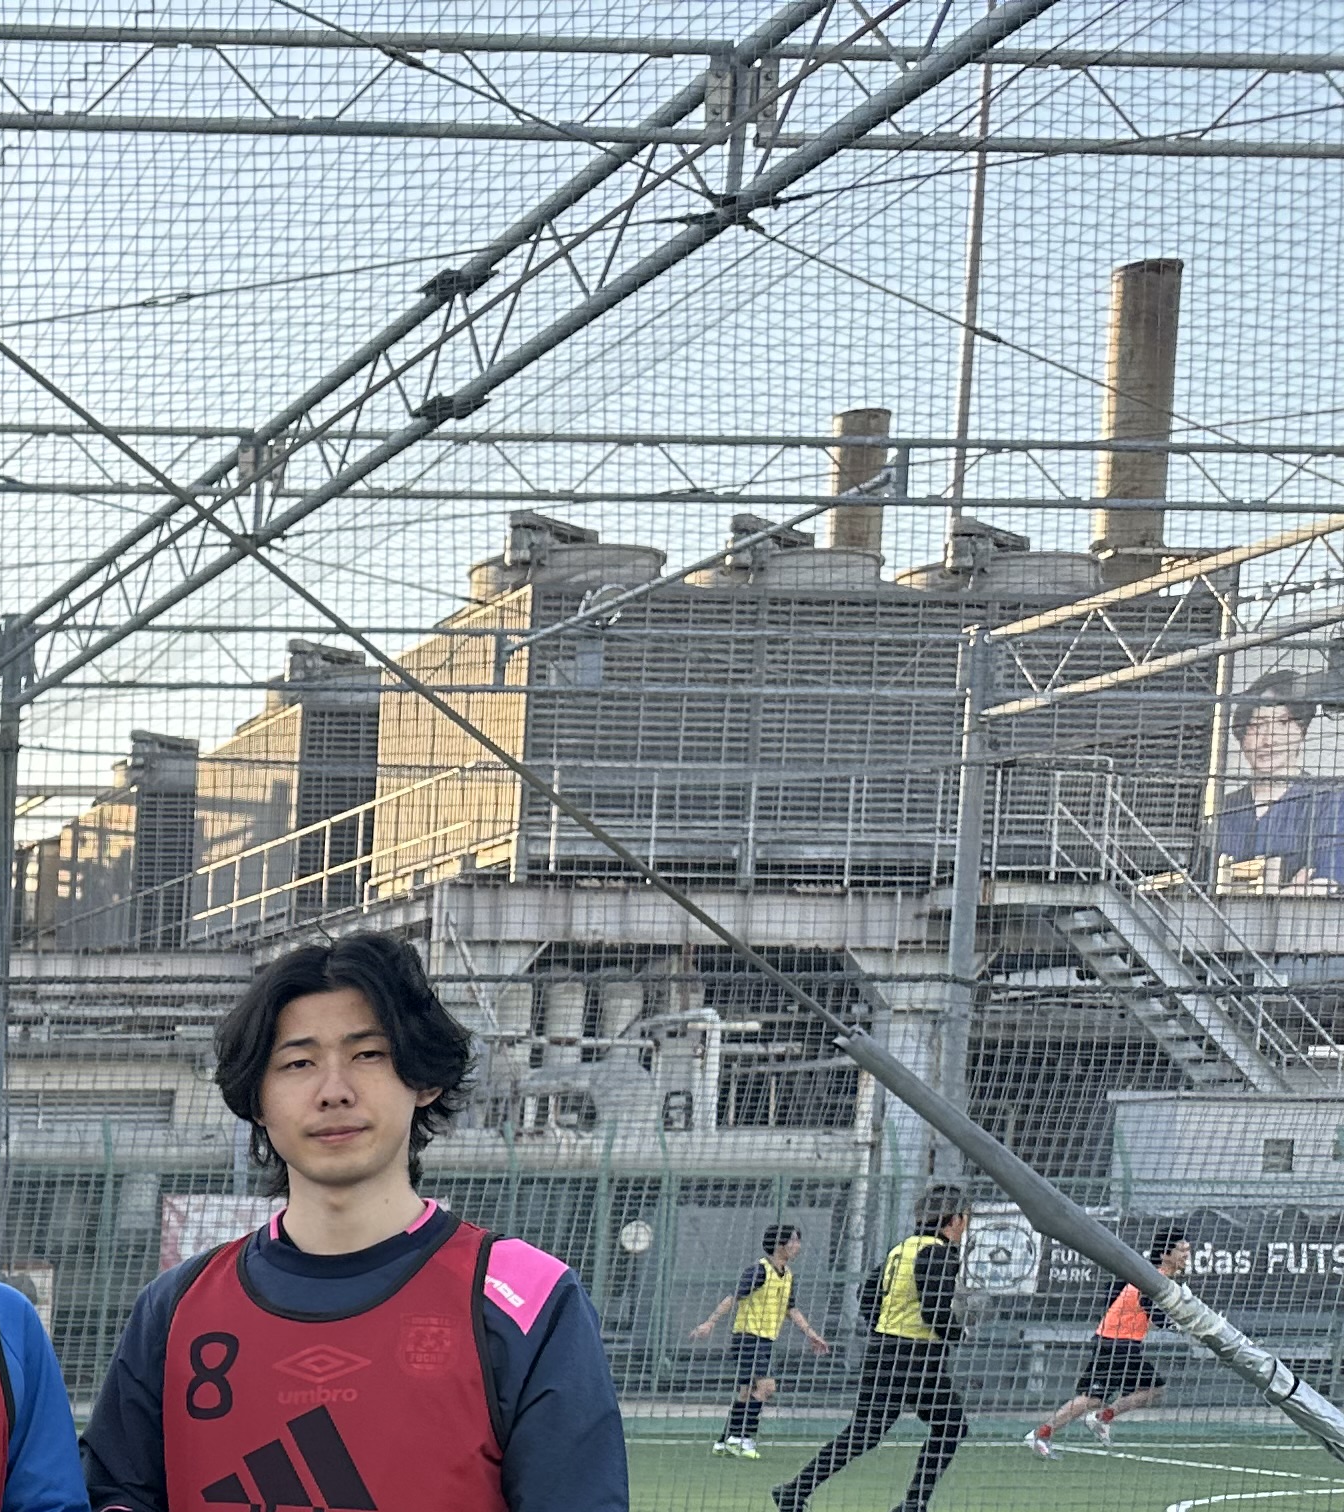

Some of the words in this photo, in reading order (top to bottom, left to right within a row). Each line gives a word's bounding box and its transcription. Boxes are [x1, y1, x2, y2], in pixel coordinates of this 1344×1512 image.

[1049, 1266, 1092, 1282] PARK
[185, 1331, 240, 1420] 8
[277, 1385, 358, 1405] umbro
